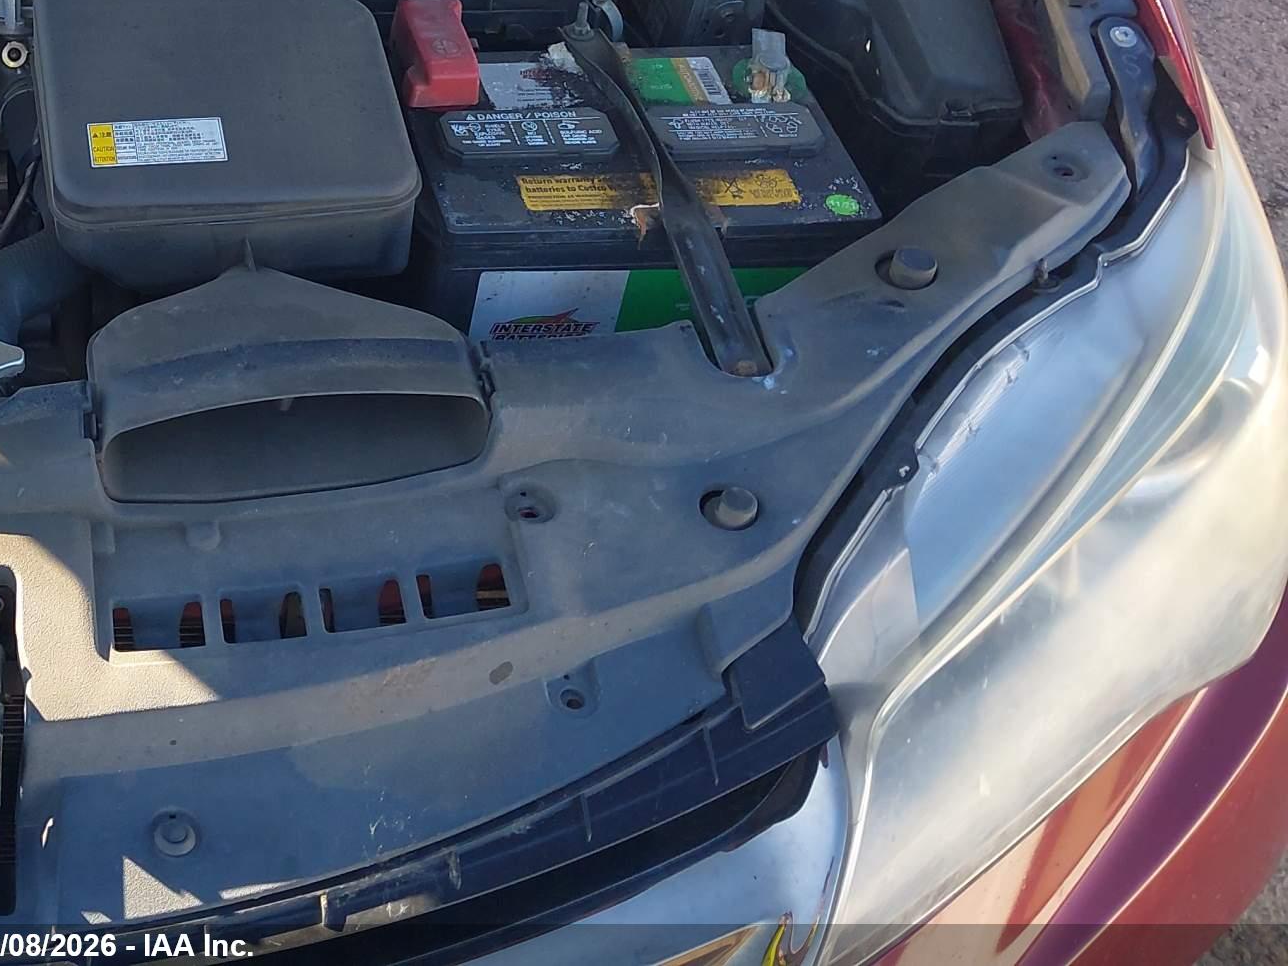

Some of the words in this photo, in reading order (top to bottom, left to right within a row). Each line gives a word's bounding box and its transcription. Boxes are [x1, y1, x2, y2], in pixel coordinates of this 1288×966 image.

[477, 113, 523, 121] DANGER
[534, 111, 577, 119] POISON
[522, 177, 553, 185] Return
[554, 176, 595, 185] warranty
[525, 185, 566, 193] batteries
[493, 323, 594, 333] INTERSTATE
